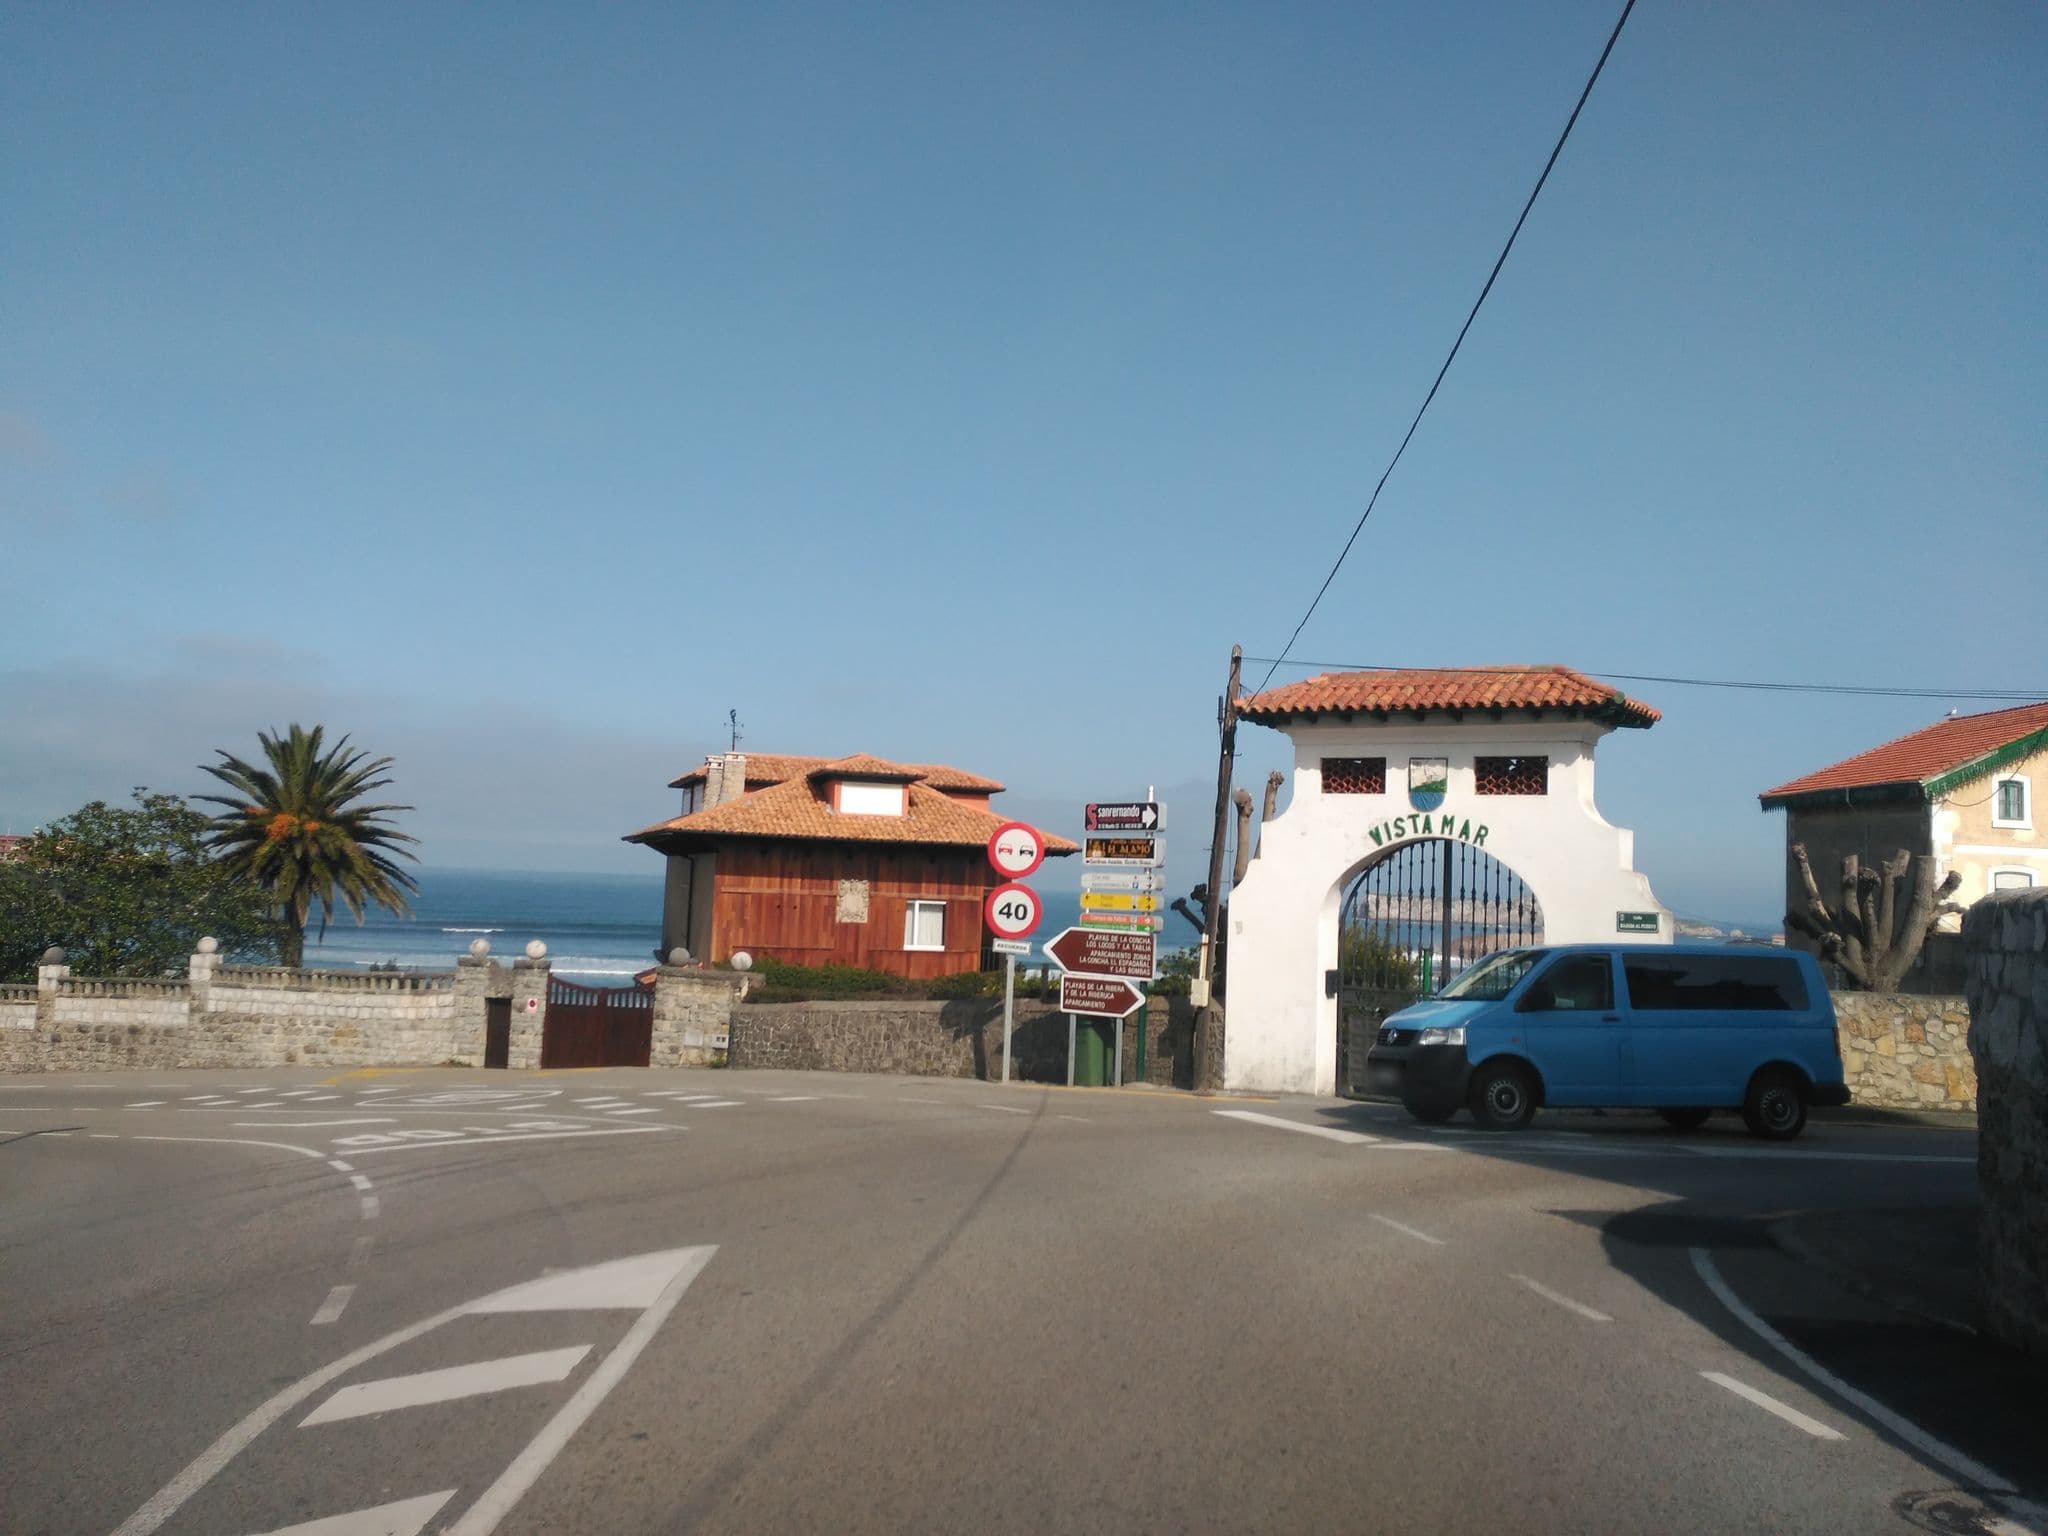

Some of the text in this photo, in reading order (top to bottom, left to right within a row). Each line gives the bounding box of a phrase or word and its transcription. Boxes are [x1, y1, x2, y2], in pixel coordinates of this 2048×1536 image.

[998, 902, 1028, 921] 40
[1088, 933, 1109, 941] PLAYAS
[1110, 935, 1118, 943] DE
[1128, 937, 1151, 945] CONCHA
[1098, 942, 1115, 950] LOCOS
[1090, 950, 1132, 960] APARCAMIENTO
[1087, 957, 1109, 965] CONCHA
[1064, 981, 1086, 990] PLAYAS
[1064, 999, 1106, 1009] APARCAMIENTO
